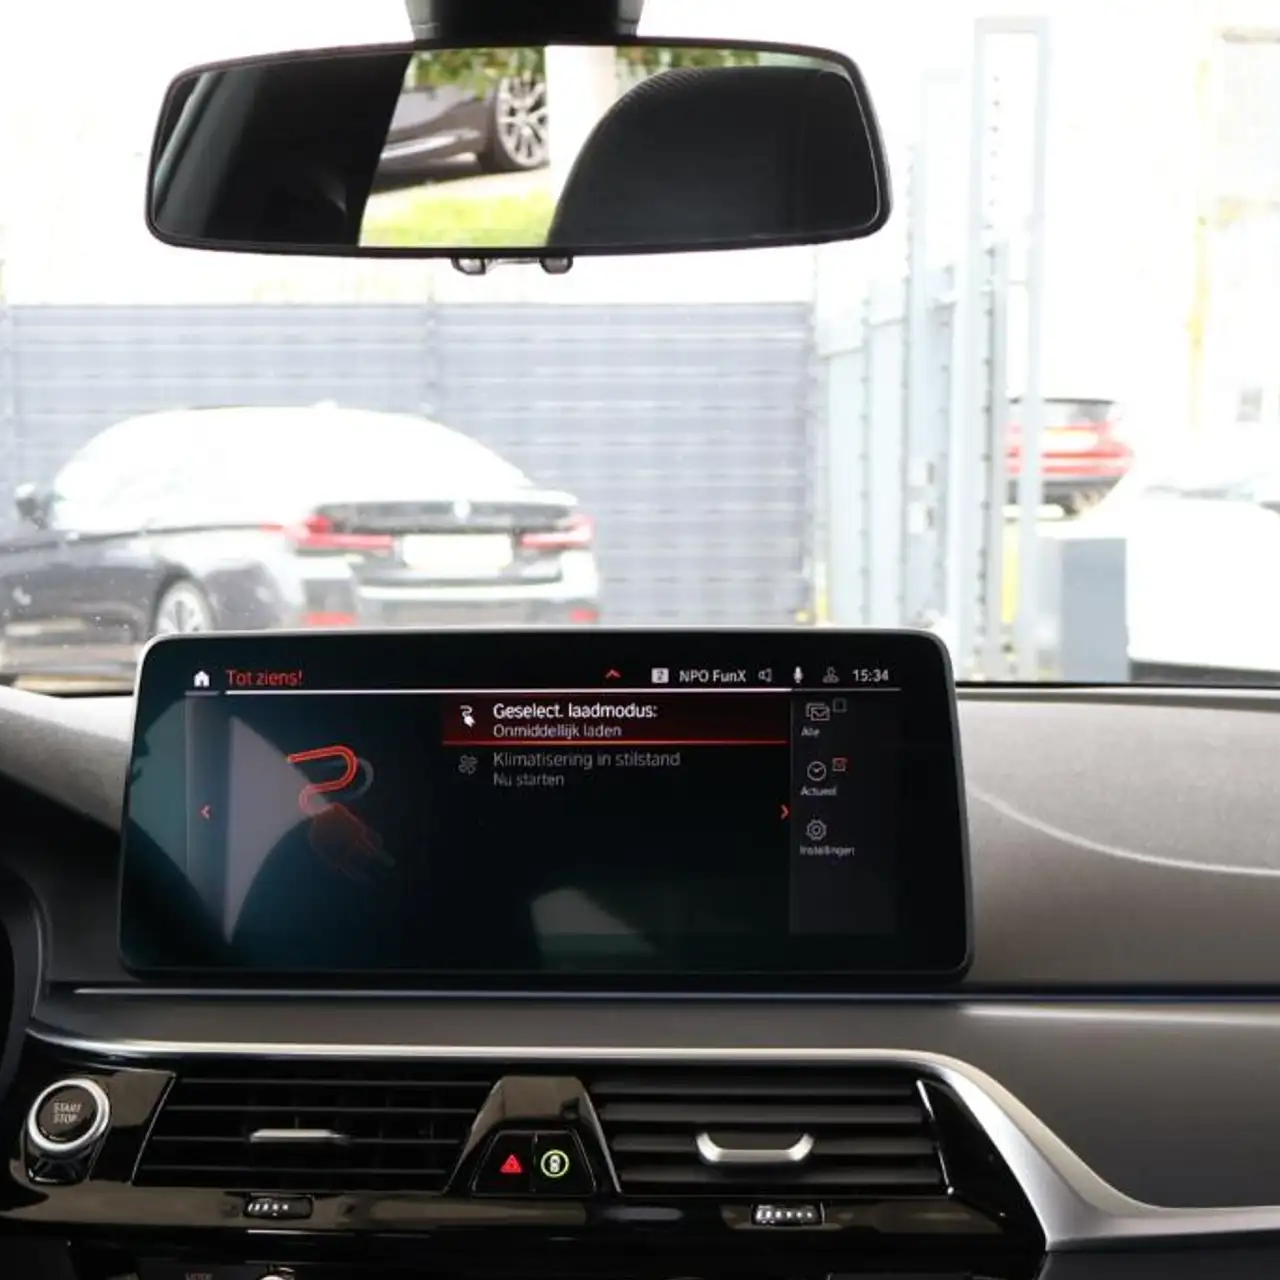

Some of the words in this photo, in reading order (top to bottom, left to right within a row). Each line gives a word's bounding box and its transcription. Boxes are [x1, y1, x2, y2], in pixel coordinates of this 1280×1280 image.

[226, 669, 252, 685] Tot
[256, 669, 304, 685] ziens!
[679, 669, 709, 683] NPO
[713, 669, 747, 683] FunX
[853, 669, 889, 682] 15:34
[492, 703, 564, 719] Geselect.
[568, 702, 658, 719] laadmodus:
[493, 723, 580, 740] Onmiddellijk
[583, 723, 622, 738] laden
[493, 752, 593, 770] Klimatisering
[597, 752, 612, 766] in
[615, 752, 681, 767] stilstand
[493, 773, 512, 786] Nu
[516, 773, 565, 787] starten
